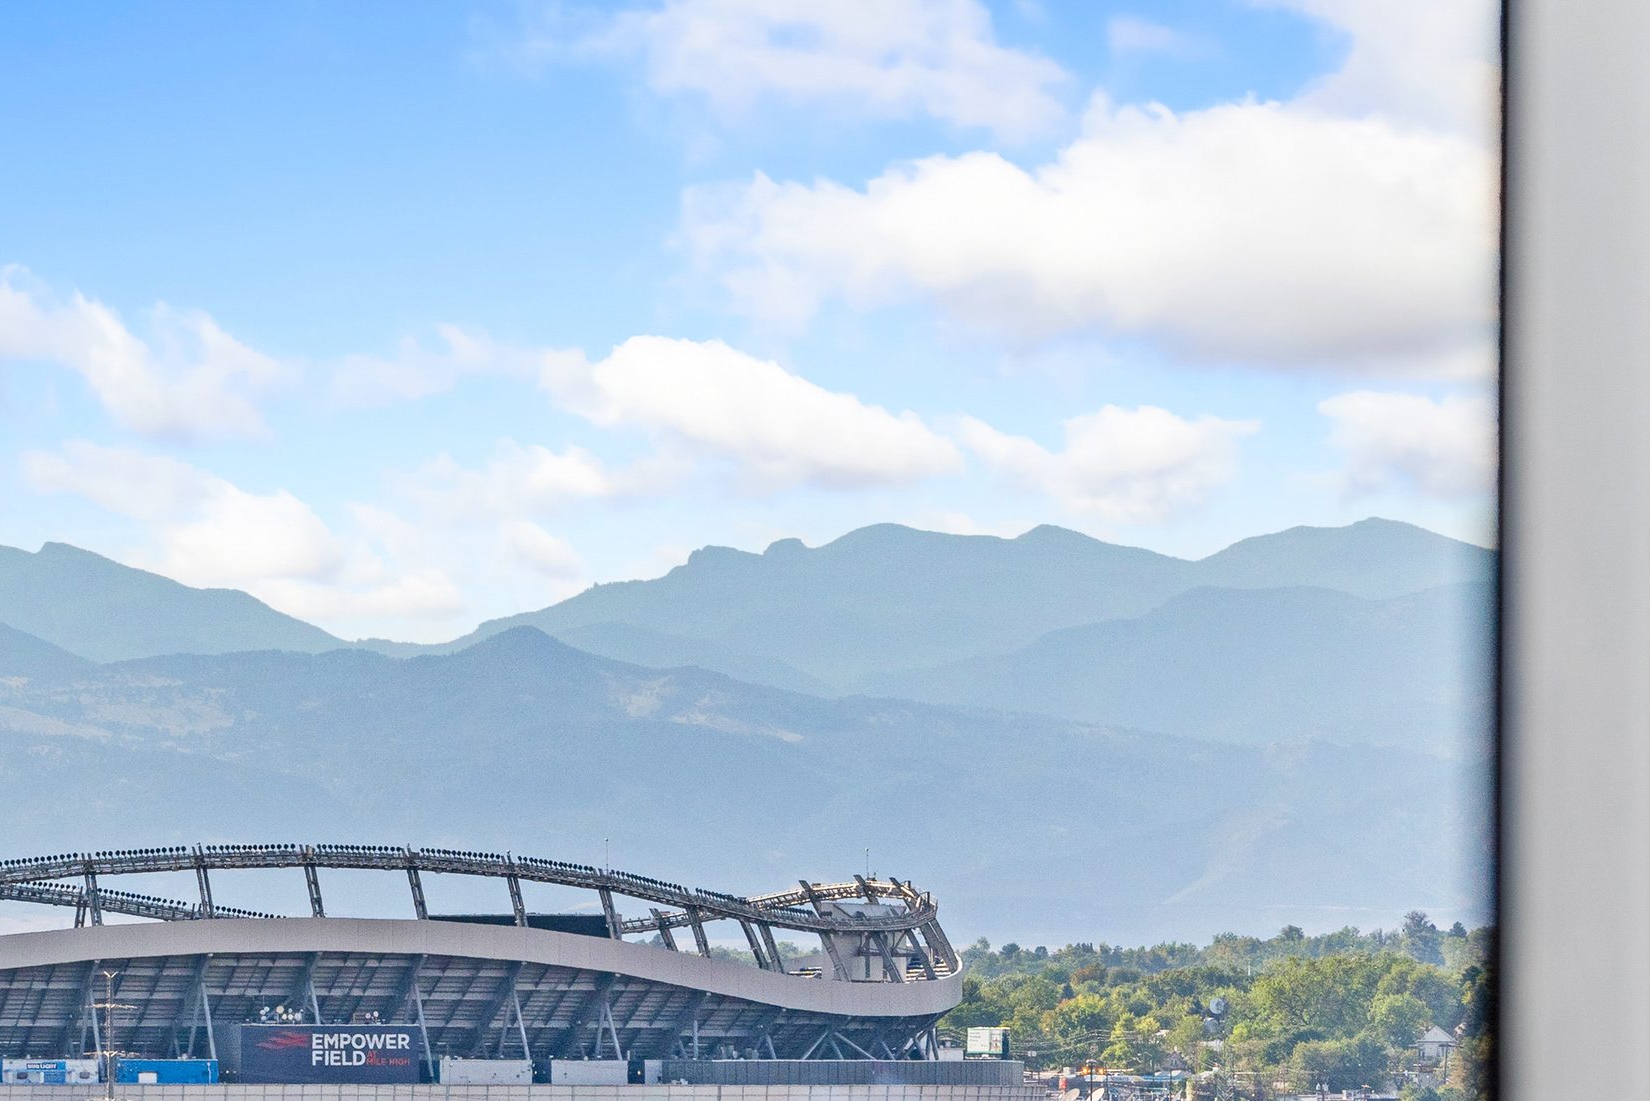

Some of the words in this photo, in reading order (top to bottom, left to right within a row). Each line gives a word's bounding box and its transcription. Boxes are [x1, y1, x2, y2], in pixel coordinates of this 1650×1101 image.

[312, 1033, 410, 1049] EMPOWER
[312, 1050, 366, 1066] FIELD
[366, 1058, 386, 1066] MILE
[389, 1058, 410, 1066] HIGH
